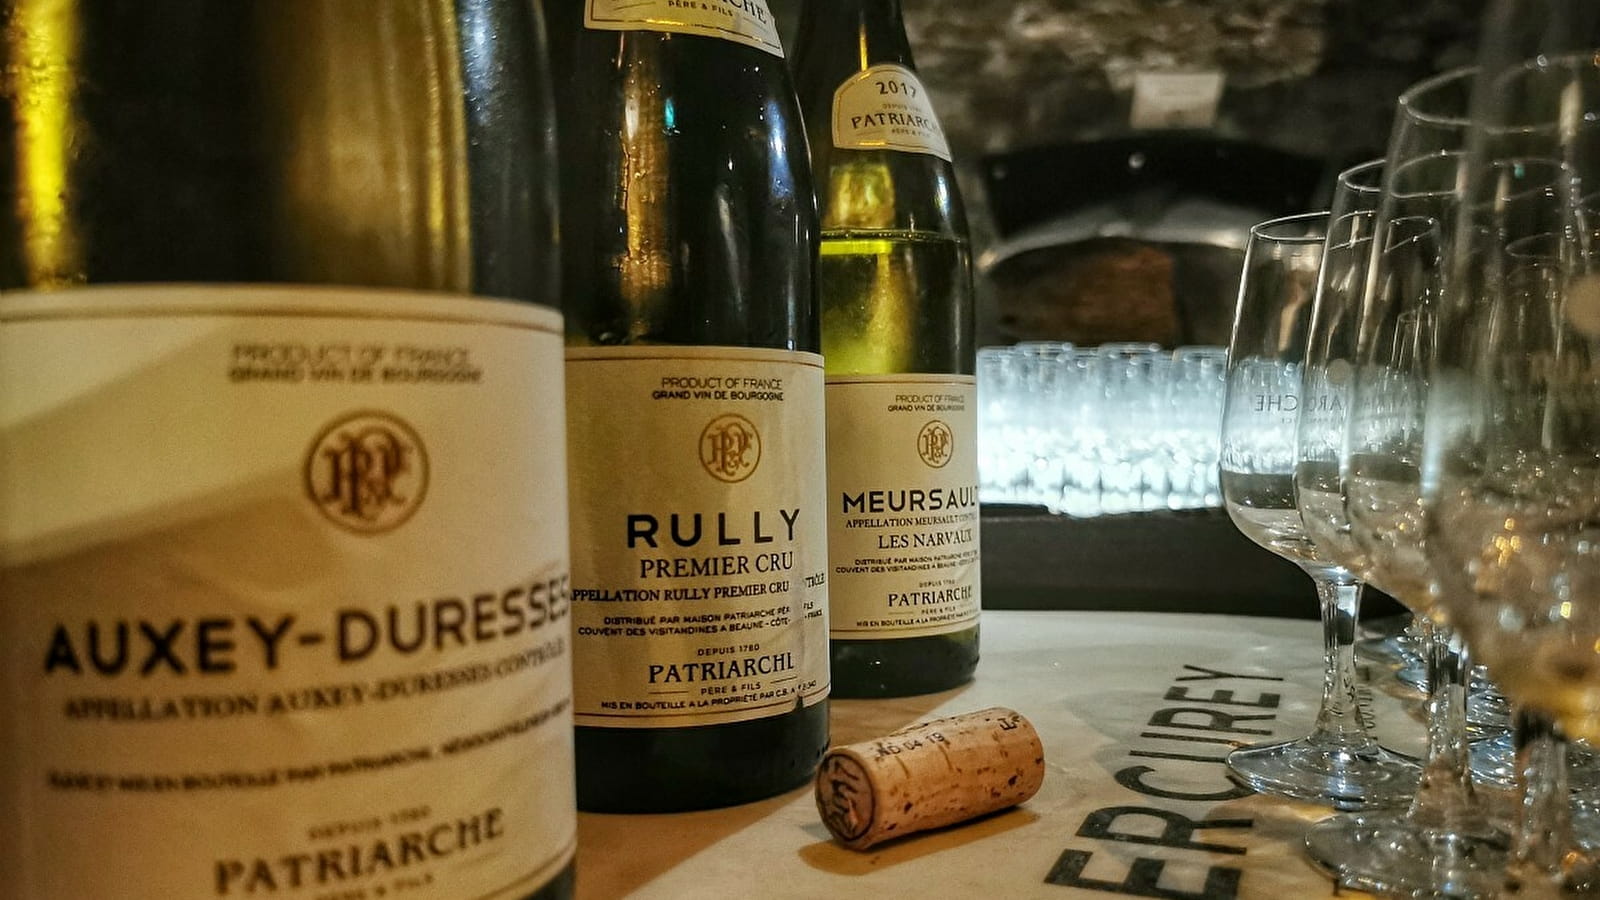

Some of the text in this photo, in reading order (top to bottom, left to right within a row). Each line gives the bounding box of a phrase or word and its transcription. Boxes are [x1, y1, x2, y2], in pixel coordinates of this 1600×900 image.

[875, 80, 916, 98] 2017
[661, 377, 783, 390] PRODUCT OF FRANCE
[652, 390, 784, 401] GRAND VIN DE BOURGOGNE
[842, 485, 978, 513] MEURSAUL
[626, 508, 800, 549] RULLY
[846, 516, 913, 528] APPELLATION
[878, 534, 909, 549] LES
[640, 551, 794, 579] PREMIER CRU
[836, 566, 869, 574] COUVENT
[570, 588, 660, 602] PPELLATION
[664, 586, 711, 601] RULLY
[714, 583, 767, 598] PREMIER
[769, 581, 790, 594] CRU
[888, 584, 972, 607] PATRIARCHE
[45, 574, 569, 676] AUXEY-DURESSES
[604, 615, 656, 625] DISTRIBUÉ
[660, 616, 680, 624] PAR
[684, 612, 721, 624] MAISON
[723, 608, 776, 620] PATRIARCHE
[578, 627, 622, 637] COUVENT
[626, 628, 646, 636] DES
[649, 625, 718, 637] VISITANDINES
[729, 619, 763, 632] BEAUNE
[697, 644, 760, 657] DEPUIS 1780
[701, 683, 727, 695] PÈRE
[741, 682, 762, 692] FILS
[601, 701, 617, 709] MIS
[620, 701, 633, 710] EN
[636, 700, 686, 710] BOUTEILLE
[697, 698, 710, 707] LA
[760, 690, 774, 699] PAR
[213, 806, 504, 896] PATRIARCHE
